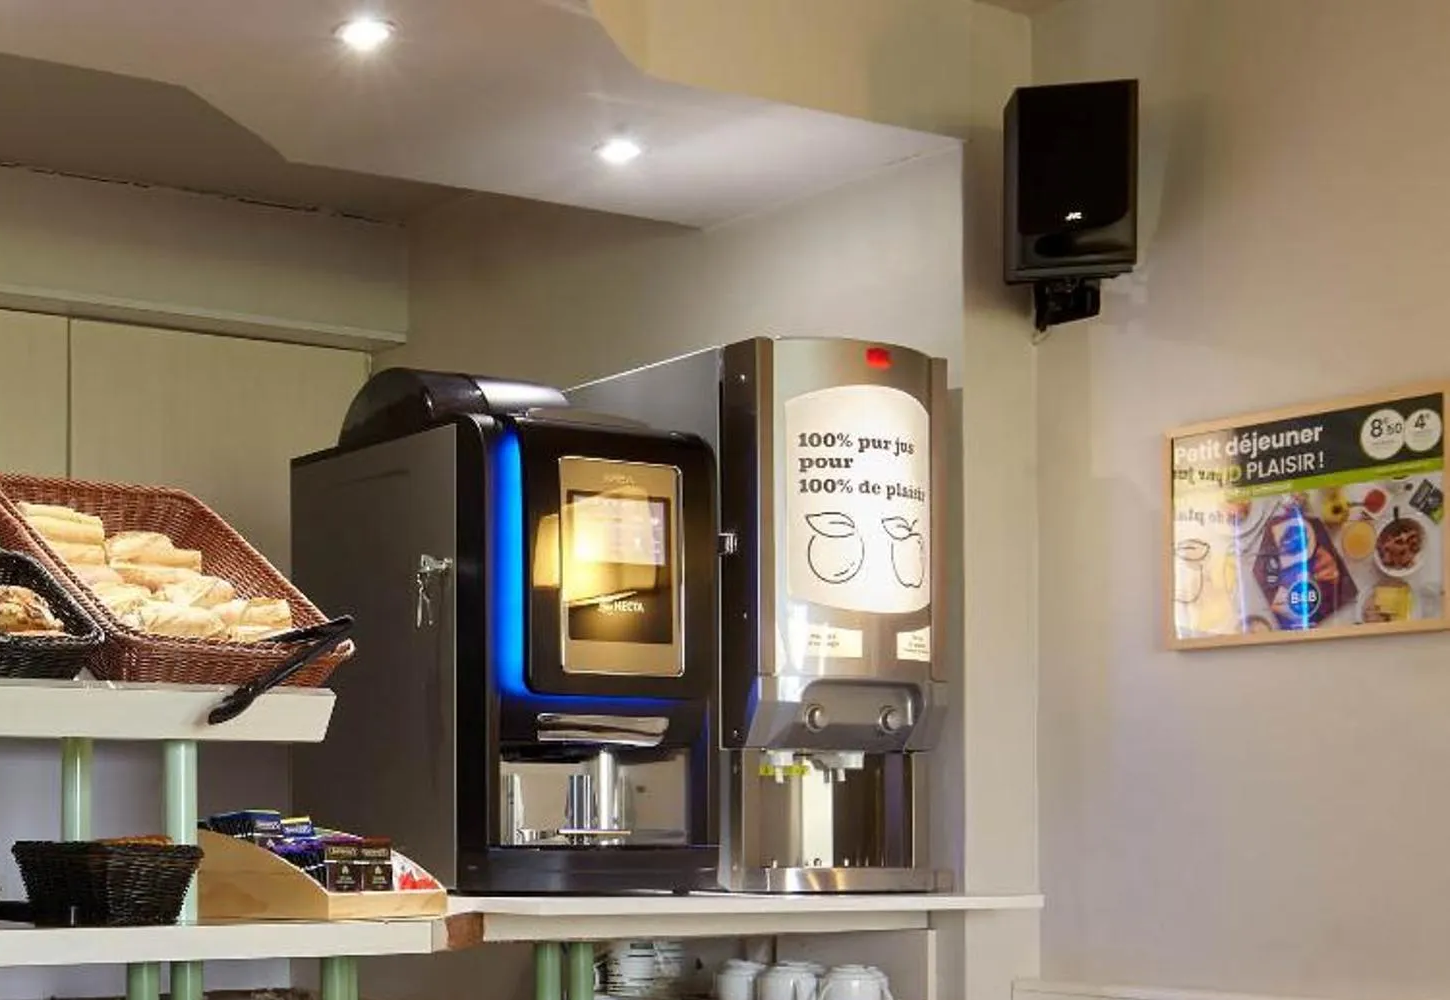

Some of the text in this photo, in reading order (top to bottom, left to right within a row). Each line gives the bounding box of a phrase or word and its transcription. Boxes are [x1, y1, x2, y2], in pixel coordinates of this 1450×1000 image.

[798, 432, 915, 456] 100% pur jus
[1175, 425, 1323, 464] Petit déjeuner
[798, 456, 854, 473] pour
[1246, 453, 1315, 480] PLAISIR
[798, 479, 853, 494] 100%
[858, 479, 881, 495] de
